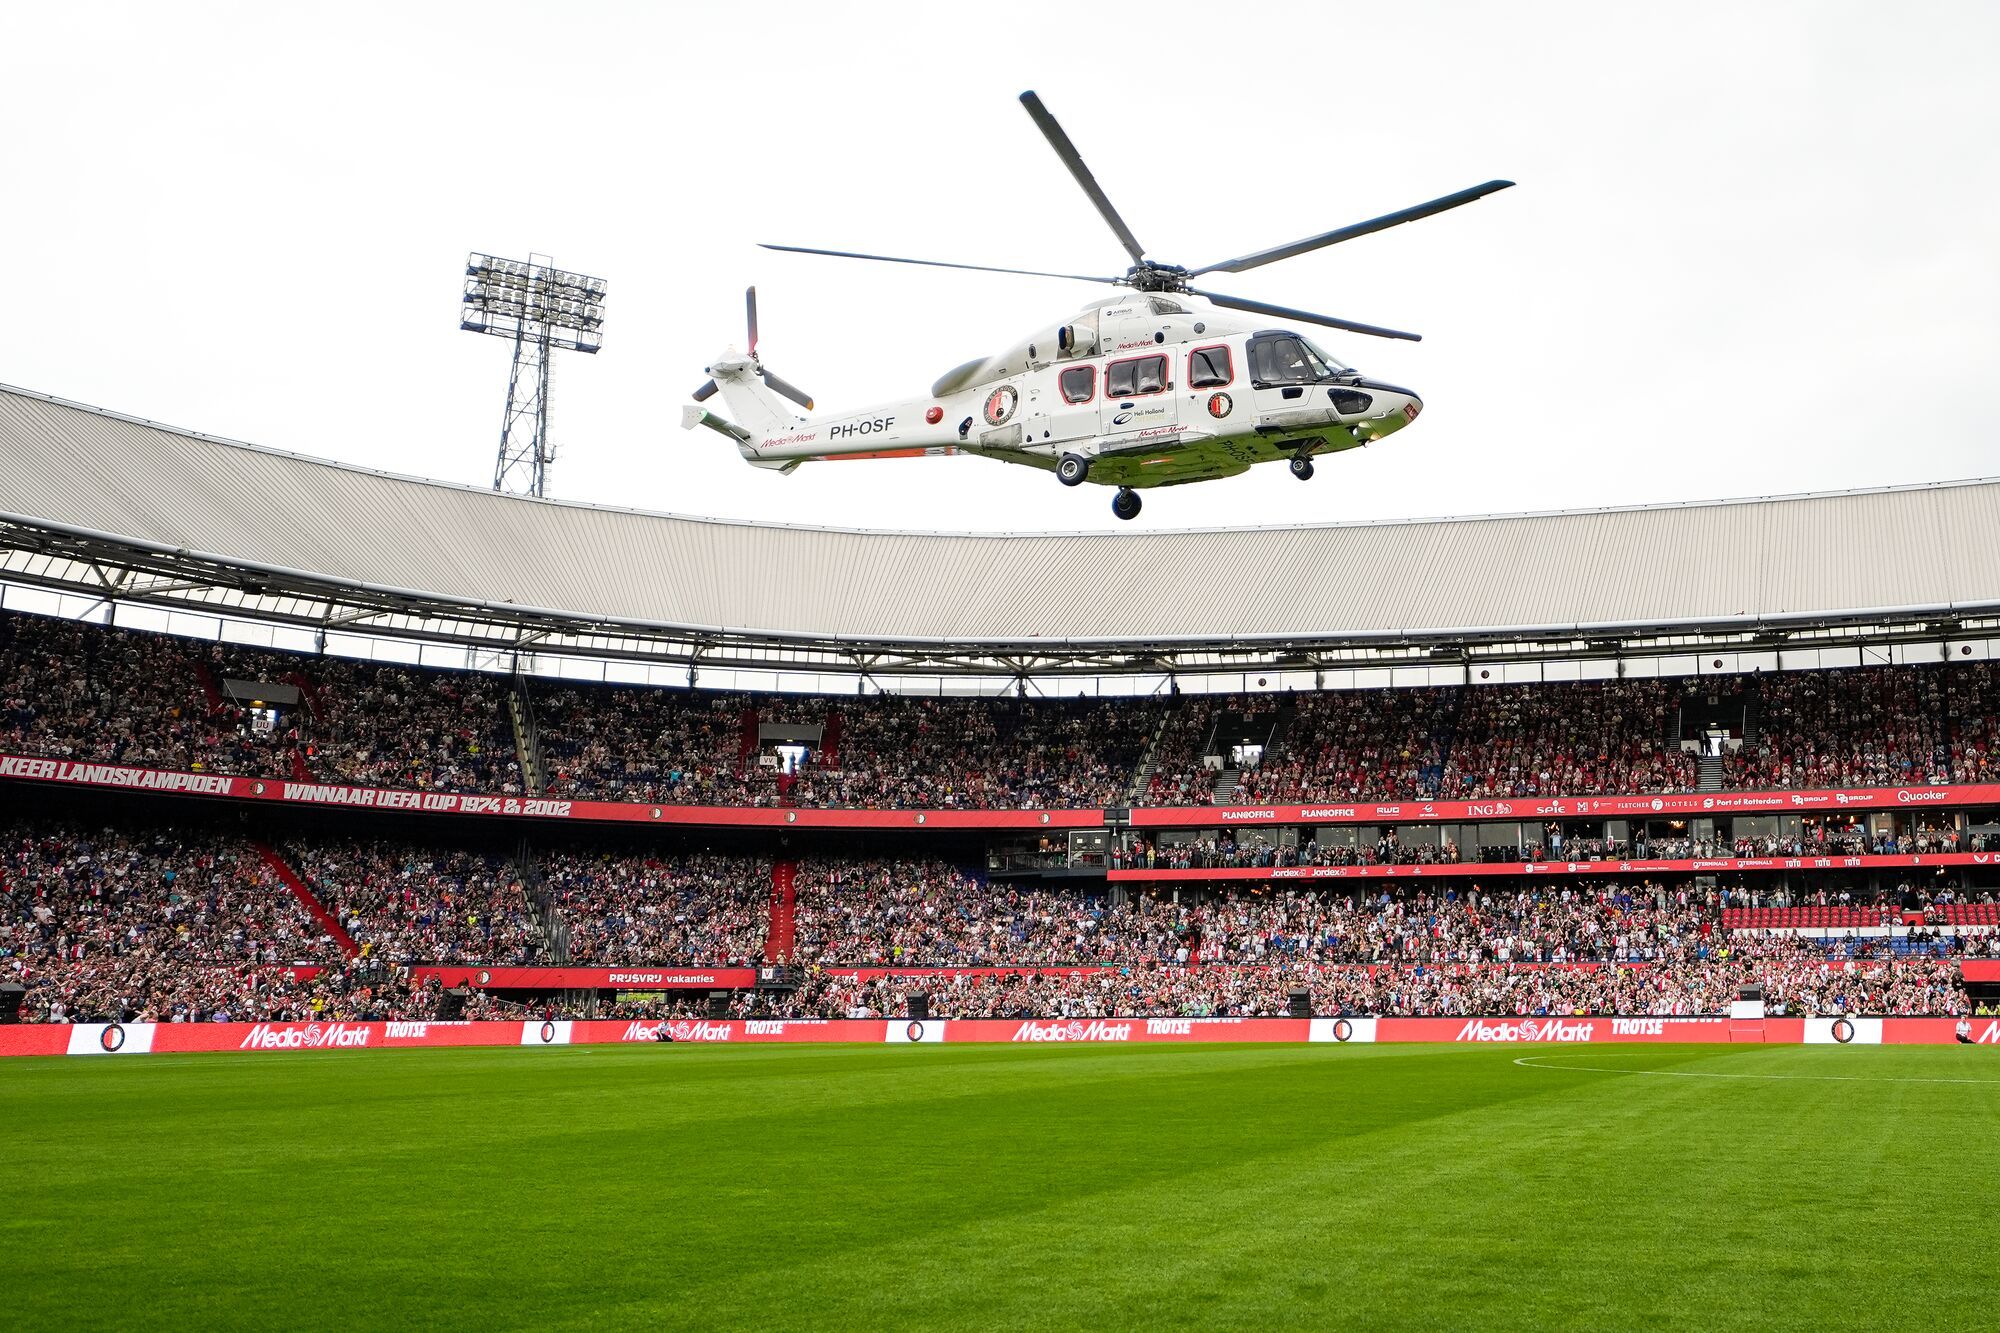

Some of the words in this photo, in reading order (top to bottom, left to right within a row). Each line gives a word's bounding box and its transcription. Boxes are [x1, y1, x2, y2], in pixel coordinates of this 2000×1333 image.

[1145, 407, 1165, 415] Holland
[830, 416, 896, 440] PH-OSF
[256, 721, 269, 729] UU
[0, 756, 56, 779] KEER
[55, 762, 233, 795] LANDSKAMPIOEN
[283, 783, 376, 806] WINNAAR
[376, 790, 420, 809] UEFA
[423, 794, 457, 811] CUP
[460, 796, 501, 813] 1974
[504, 798, 521, 814] &
[522, 800, 572, 816] 2002
[1743, 797, 1783, 805] Rotterdam
[1897, 790, 1947, 802] Quooker
[1467, 805, 1494, 816] ING
[1785, 858, 1801, 868] TOTO
[1814, 857, 1831, 867] TOTO
[1844, 856, 1861, 866] TOTO
[1270, 869, 1299, 878] Jordex
[1311, 868, 1341, 877] Jordex
[666, 973, 715, 984] vakanties
[384, 1021, 428, 1038] TROTSE
[688, 1022, 732, 1041] Markt
[745, 1020, 784, 1035] TROTSE
[1012, 1020, 1067, 1042] Media
[1080, 1021, 1131, 1042] Markt
[1146, 1019, 1191, 1035] TROTSE
[1456, 1019, 1519, 1042] Media
[1535, 1019, 1594, 1042] Markt
[1611, 1018, 1663, 1035] TROTSE
[240, 1023, 303, 1048] Media
[317, 1023, 371, 1047] Markt
